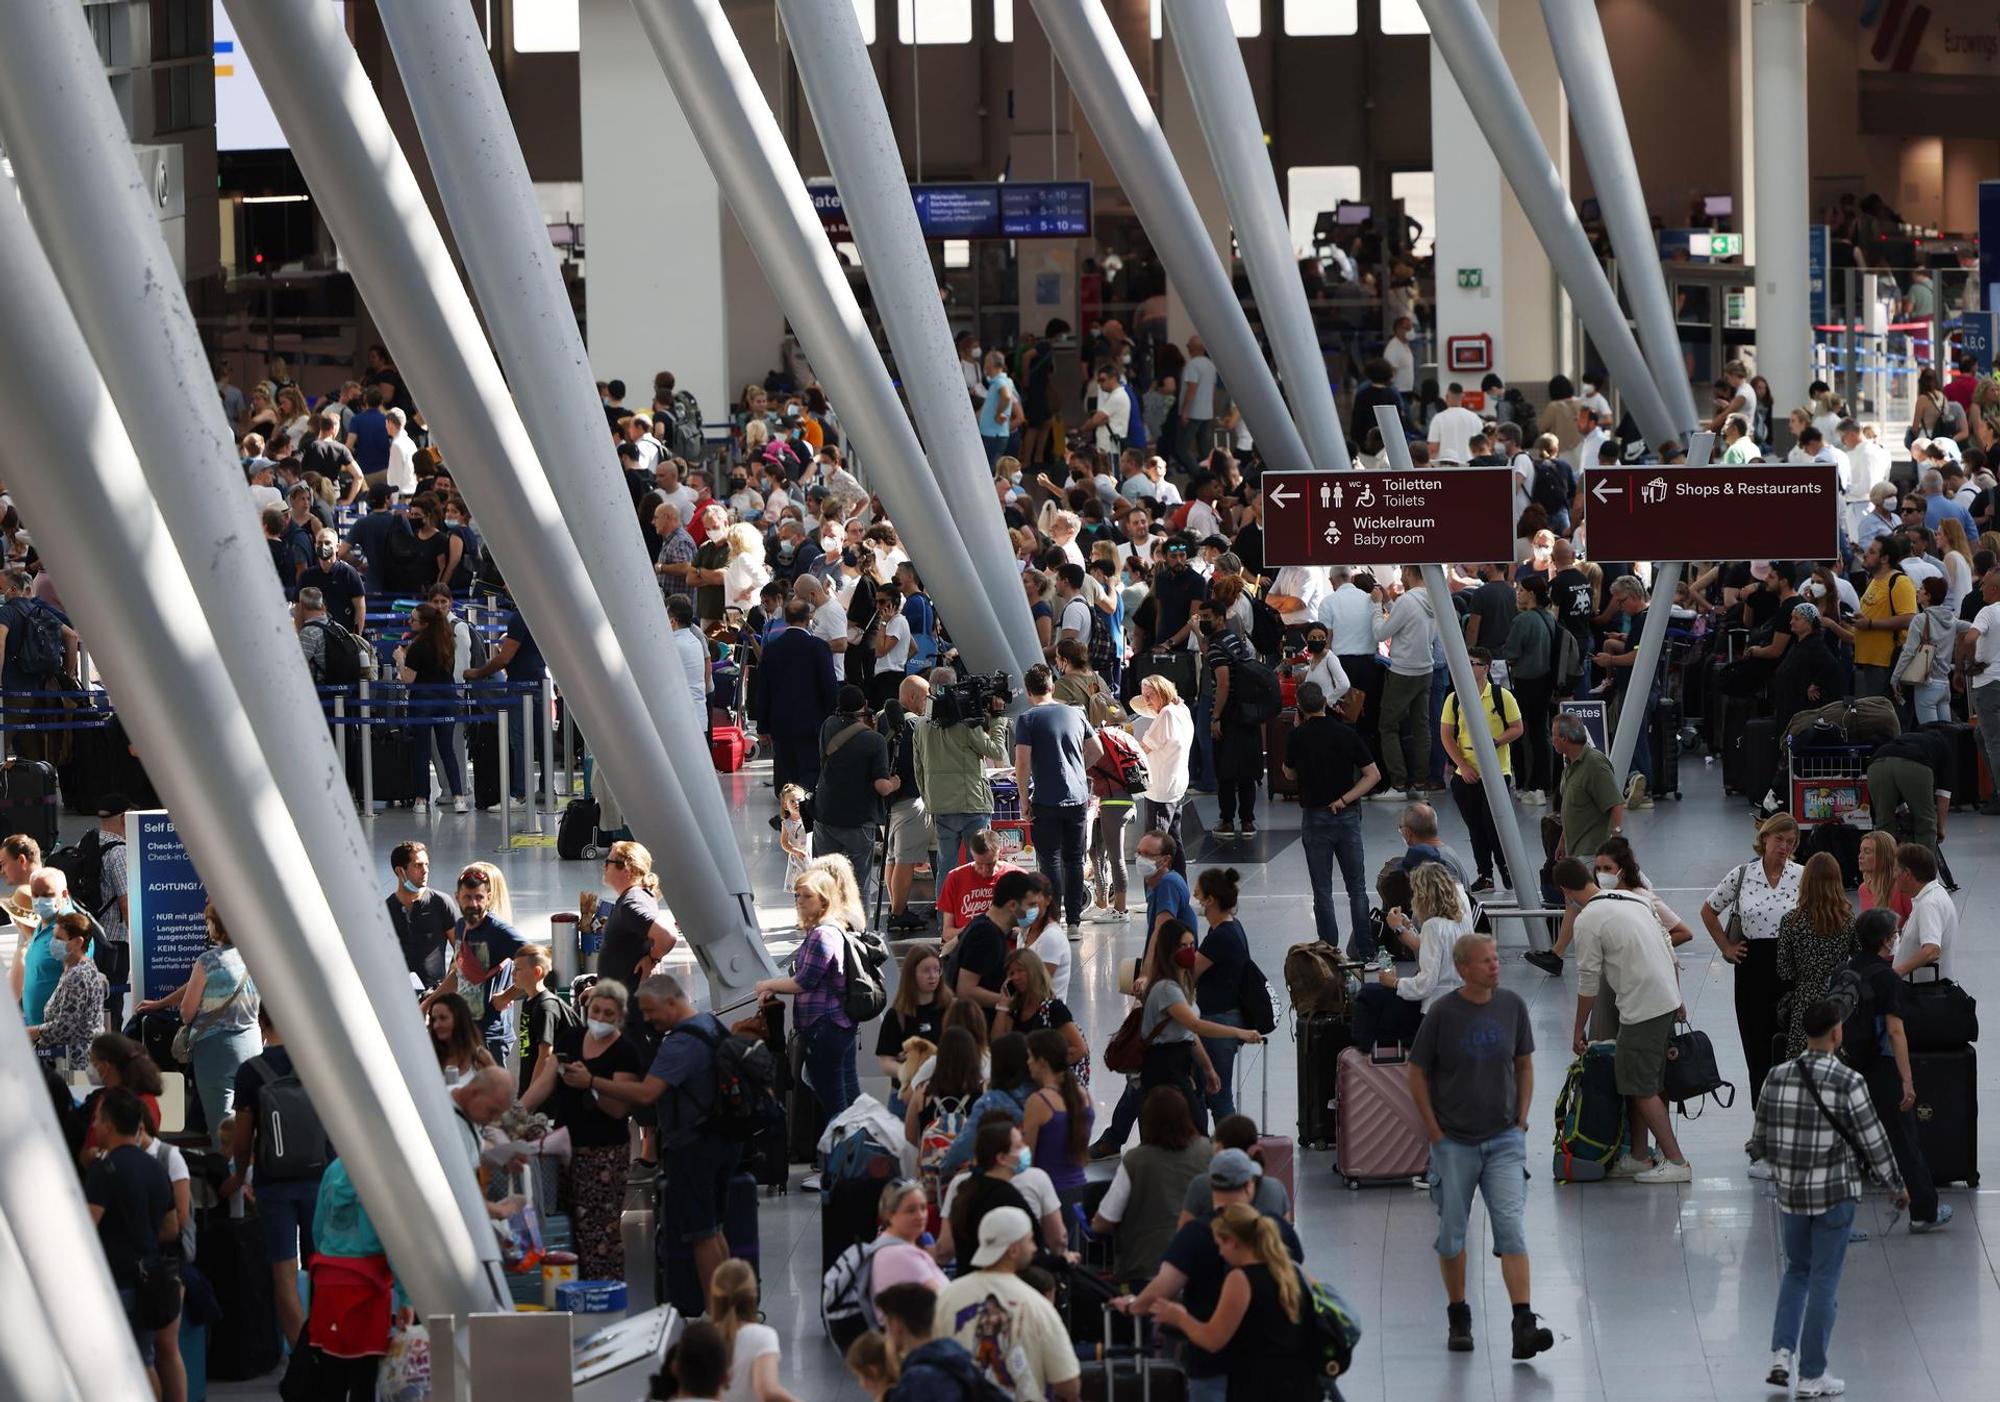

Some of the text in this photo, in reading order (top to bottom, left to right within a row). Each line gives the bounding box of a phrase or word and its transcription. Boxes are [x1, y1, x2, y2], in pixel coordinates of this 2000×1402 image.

[1040, 220, 1047, 231] 5
[1057, 220, 1069, 231] 10
[1382, 478, 1442, 491] Toiletten
[1675, 482, 1822, 498] Shops & Restaurants
[1382, 494, 1425, 507] Toilets
[1353, 516, 1435, 529] Wickelraum
[1354, 532, 1425, 548] Baby room
[1810, 793, 1834, 805] Have
[144, 822, 176, 833] Self B
[147, 841, 184, 850] Check-in
[147, 852, 181, 861] Check-in
[149, 882, 198, 891] ACHTUNG!
[156, 913, 174, 921] NUR
[175, 912, 188, 920] mit
